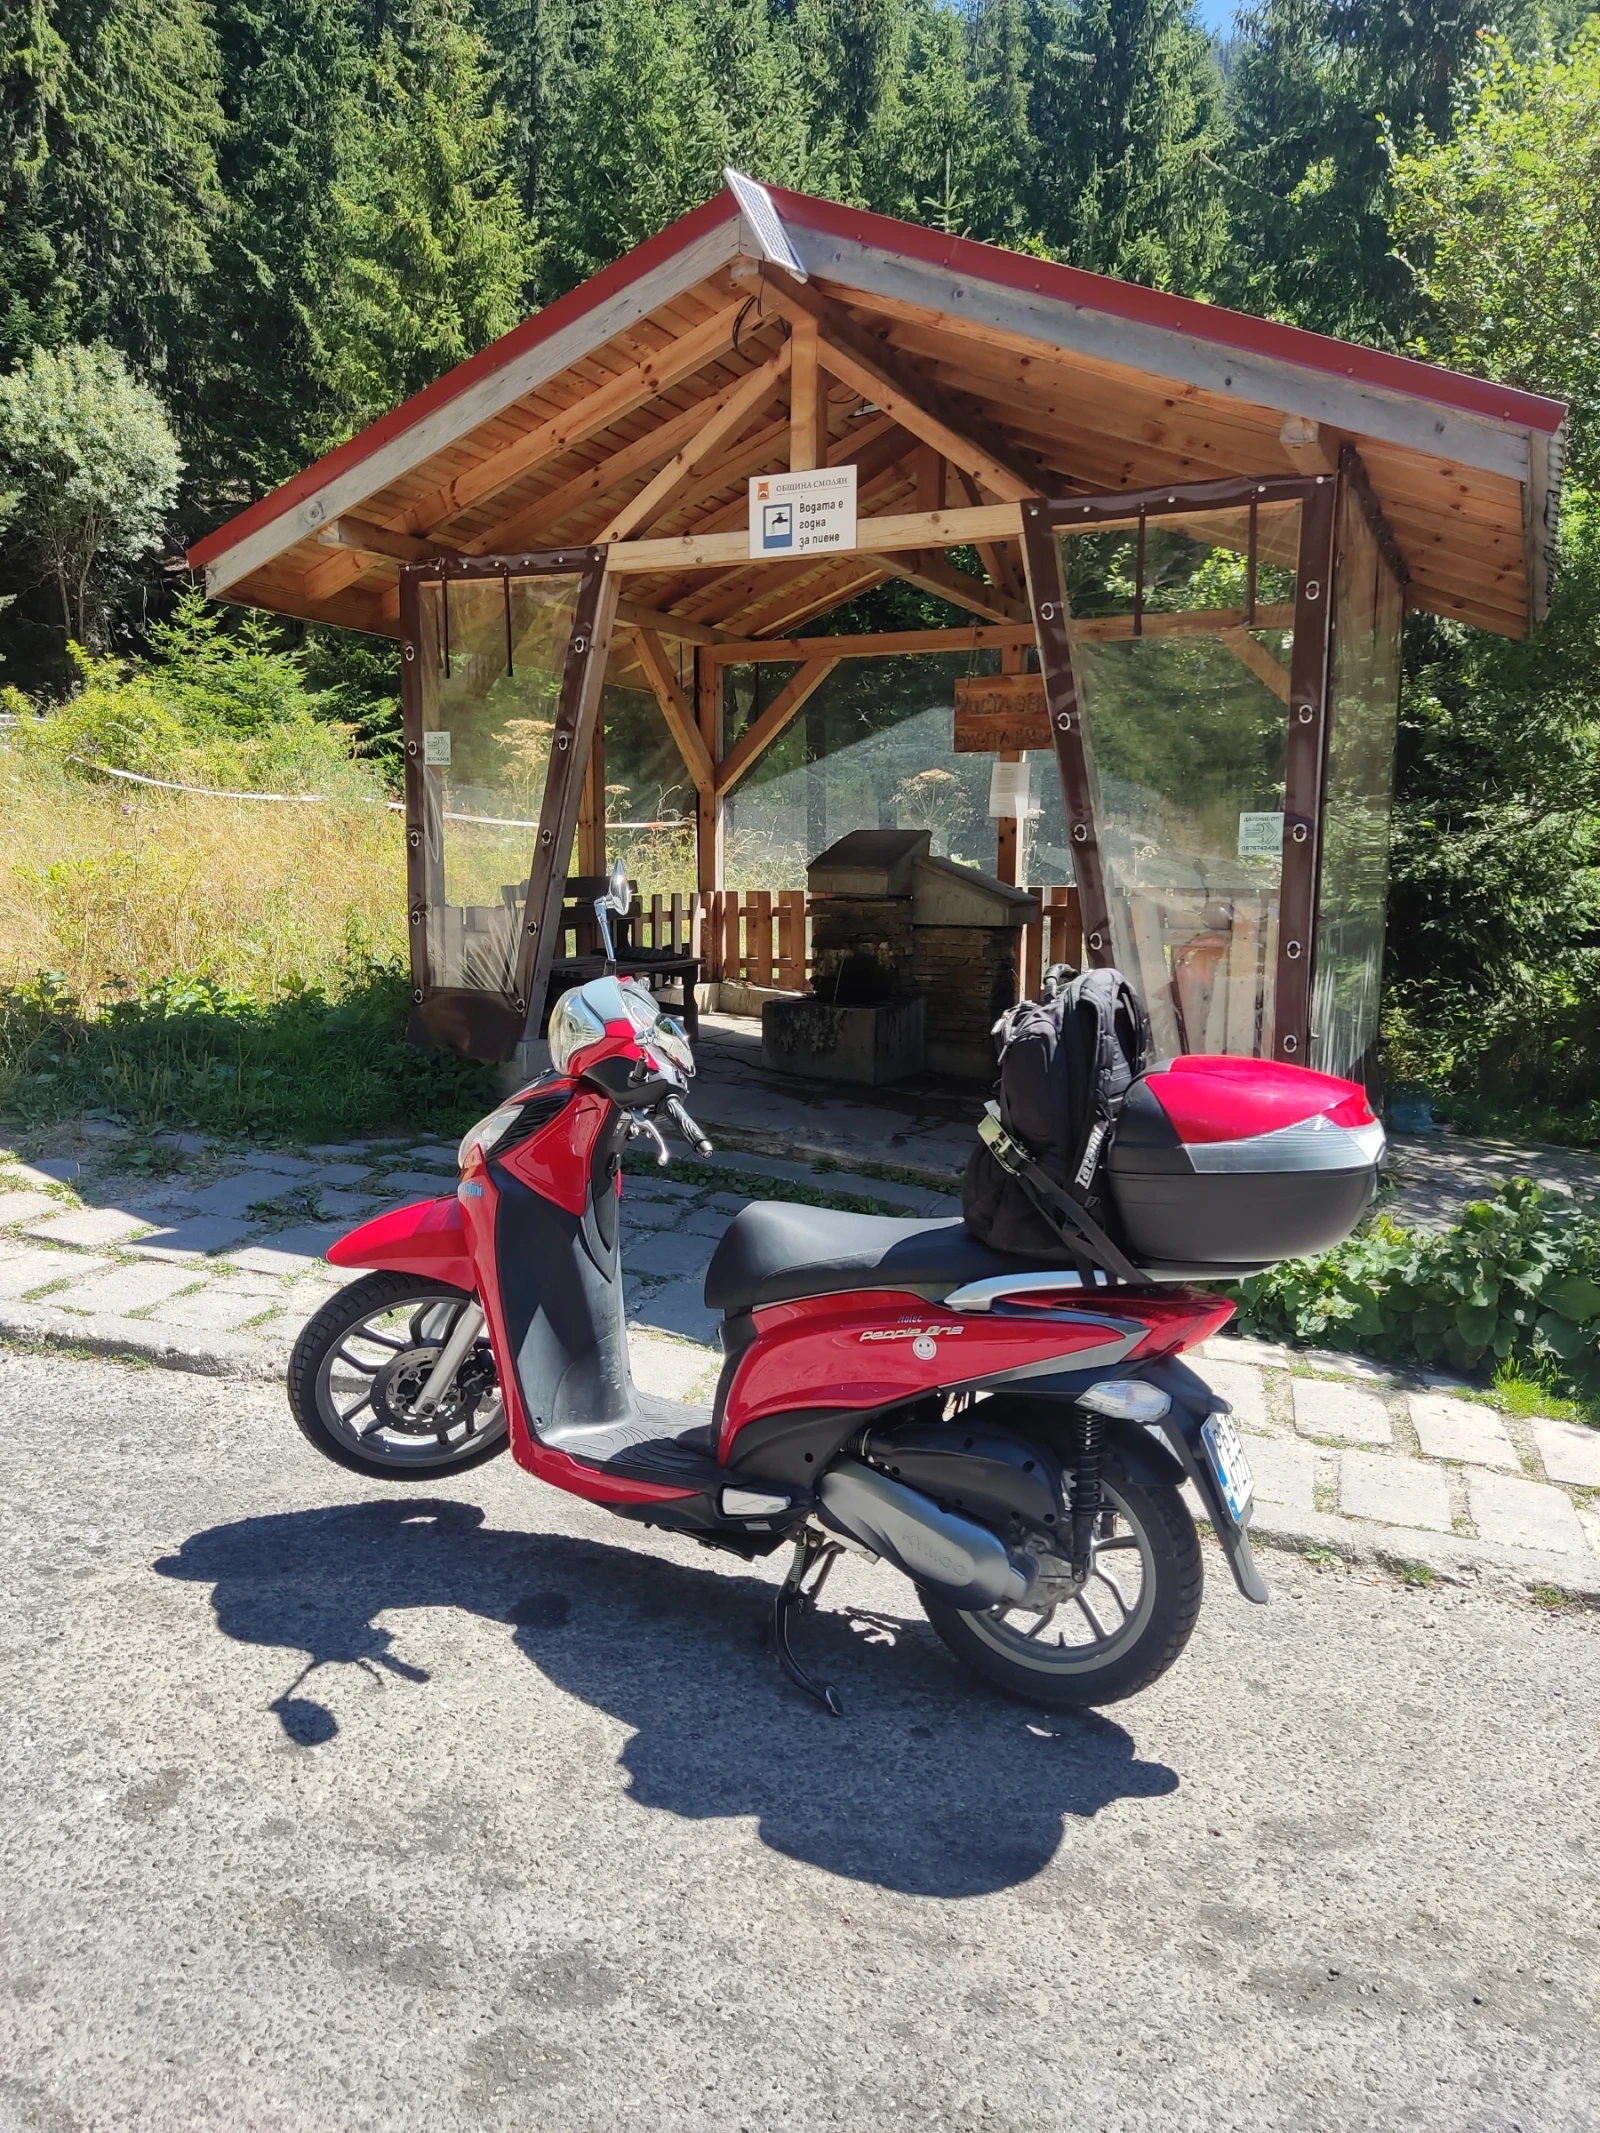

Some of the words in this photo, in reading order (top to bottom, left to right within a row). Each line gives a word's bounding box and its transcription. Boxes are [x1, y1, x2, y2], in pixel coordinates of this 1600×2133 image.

[775, 483, 812, 493] ОБЩИНА
[813, 477, 848, 488] СМОЛЯН
[799, 501, 836, 514] Водата
[838, 500, 844, 508] е
[799, 519, 826, 531] годна
[799, 536, 810, 548] за
[812, 533, 840, 544] пиене
